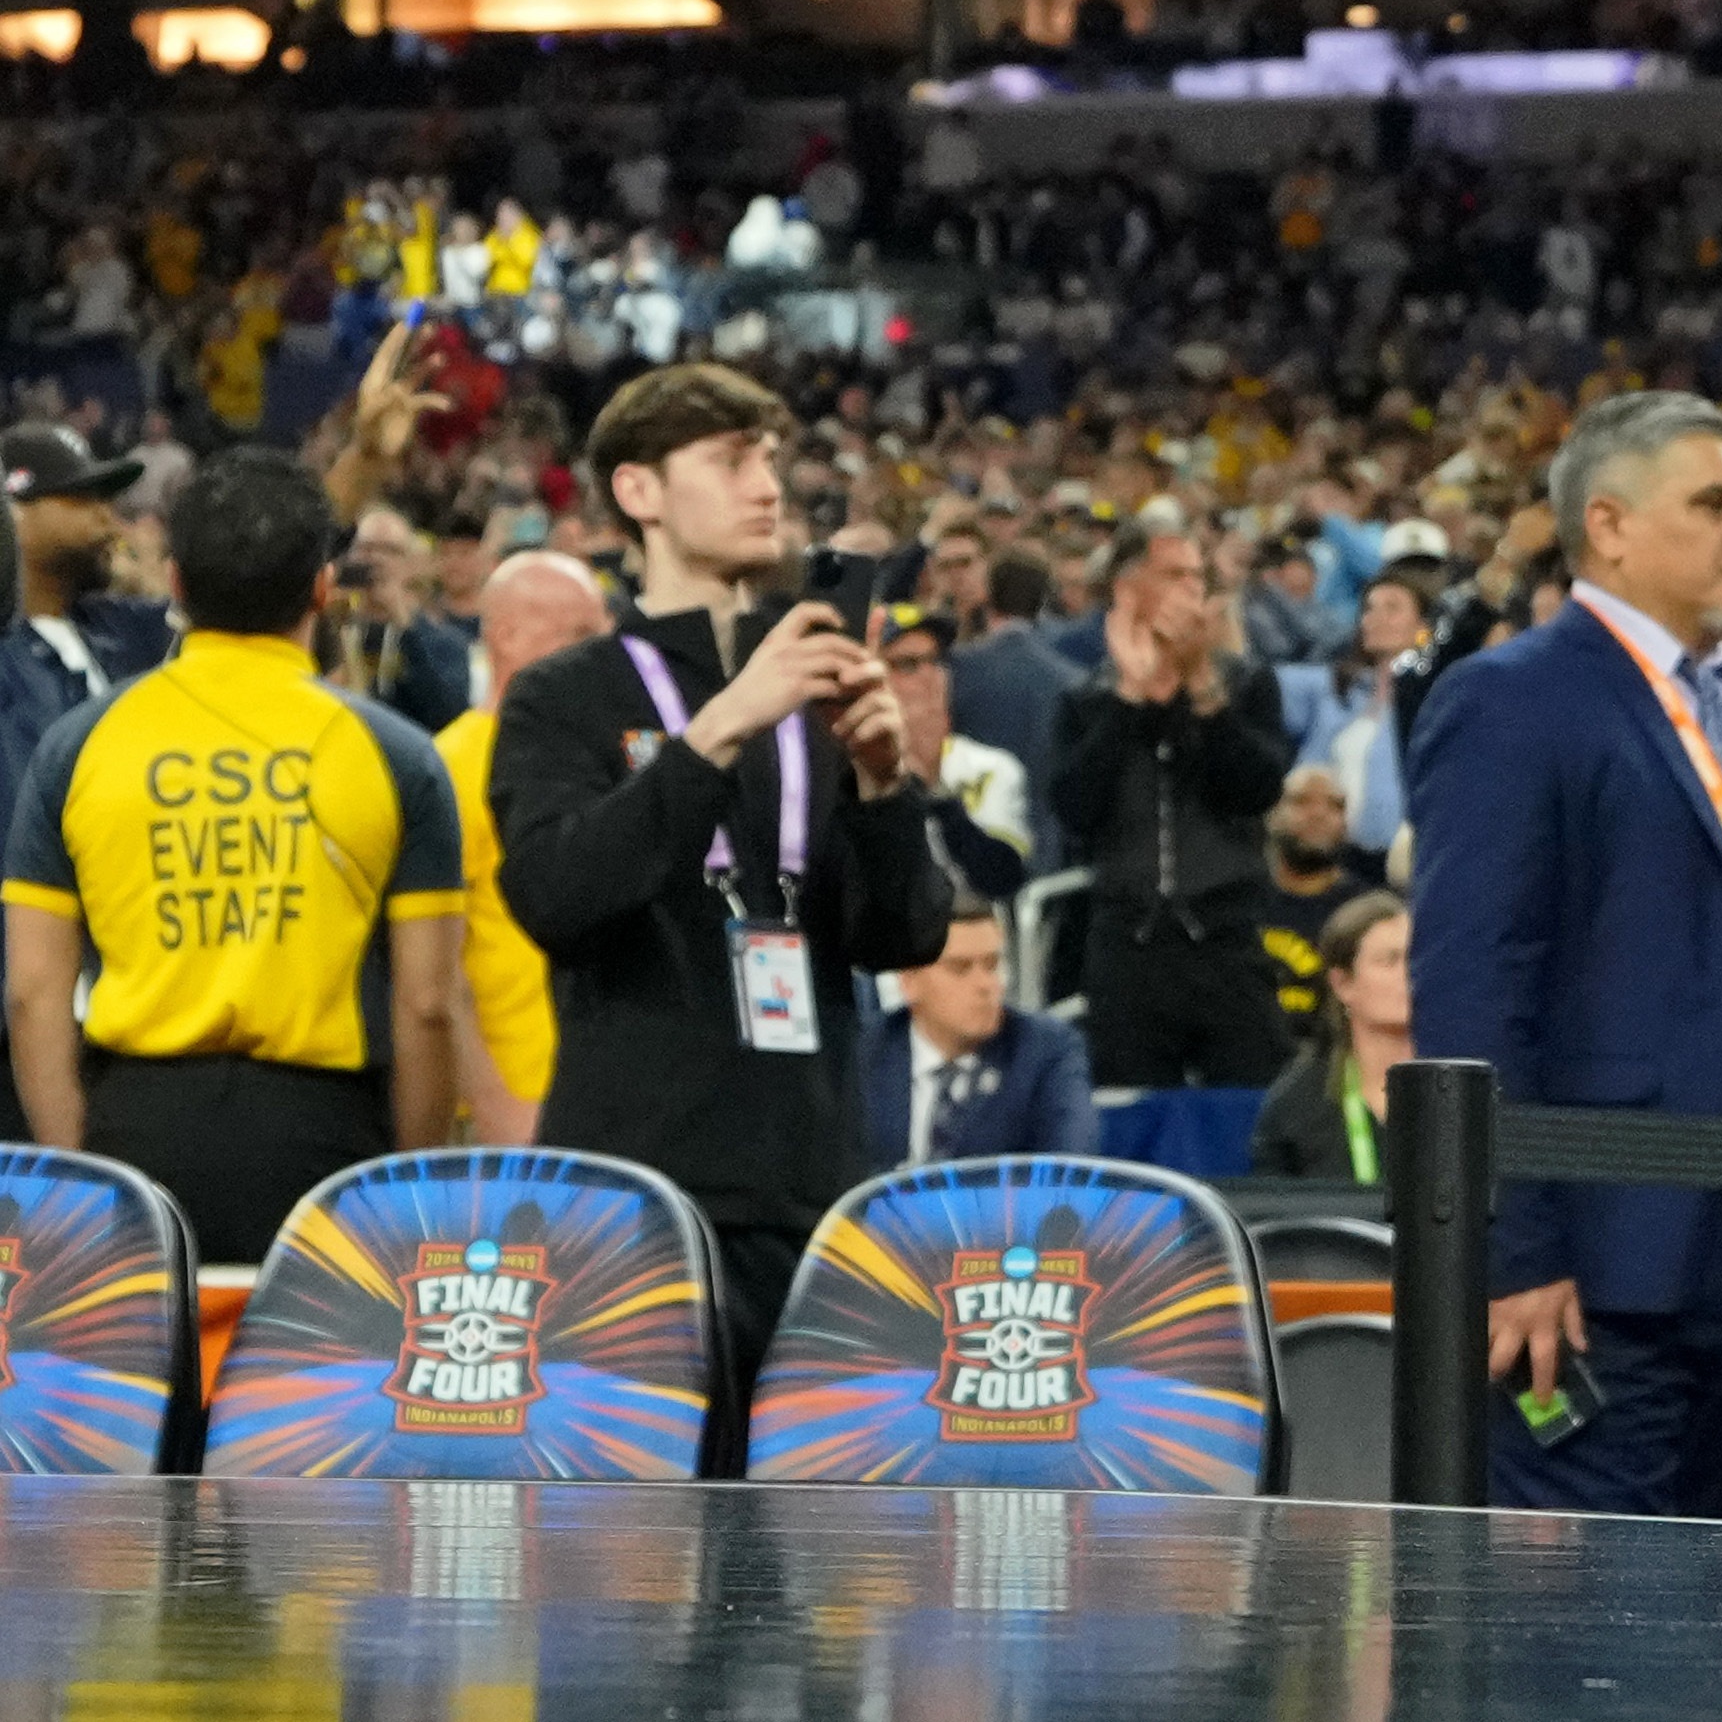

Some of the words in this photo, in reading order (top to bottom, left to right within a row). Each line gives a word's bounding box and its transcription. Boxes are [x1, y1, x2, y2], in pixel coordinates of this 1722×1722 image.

[147, 748, 312, 808] CSC
[150, 814, 312, 880] EVENT
[156, 884, 305, 951] STAFF
[417, 1275, 534, 1319] FINAL
[954, 1281, 1074, 1323] FINAL
[407, 1357, 522, 1402] FOUR
[951, 1366, 1070, 1409] FOUR
[405, 1405, 518, 1425] INDIANAPOLIS
[951, 1414, 1064, 1432] INDIANAPOLIS
